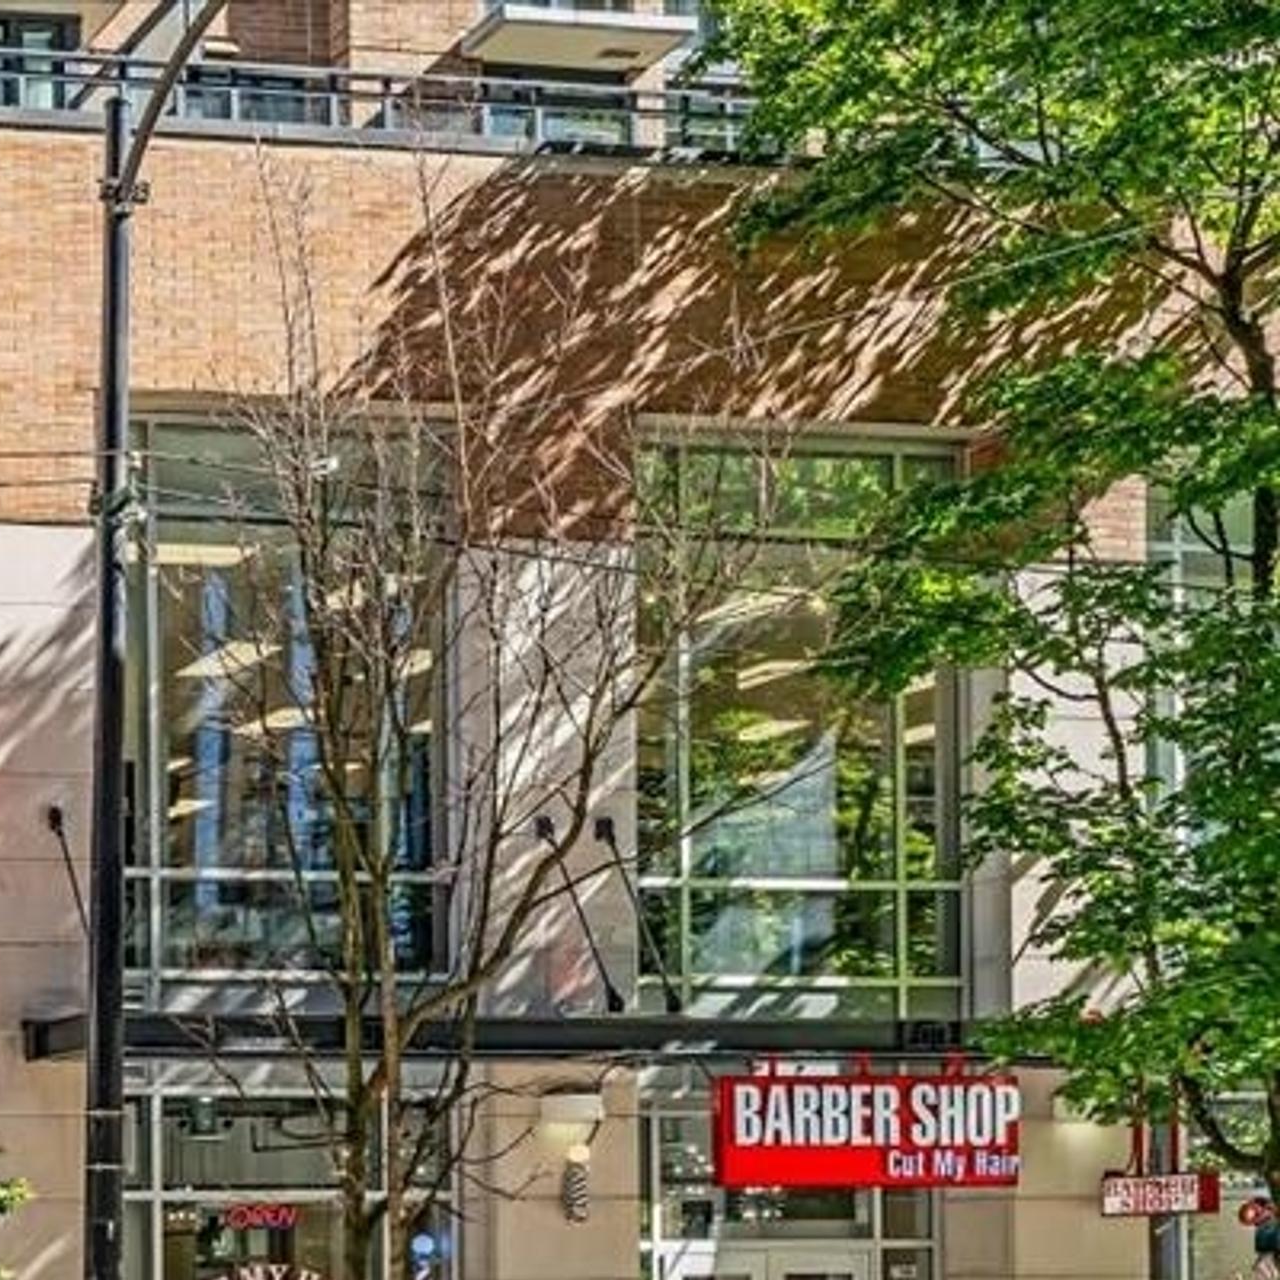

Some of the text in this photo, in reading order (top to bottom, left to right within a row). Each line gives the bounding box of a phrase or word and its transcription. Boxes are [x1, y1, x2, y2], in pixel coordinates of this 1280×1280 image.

[734, 1082, 1022, 1147] BARBER SHOP
[888, 1151, 1022, 1180] Cut My Hair
[228, 1206, 297, 1230] OPEN
